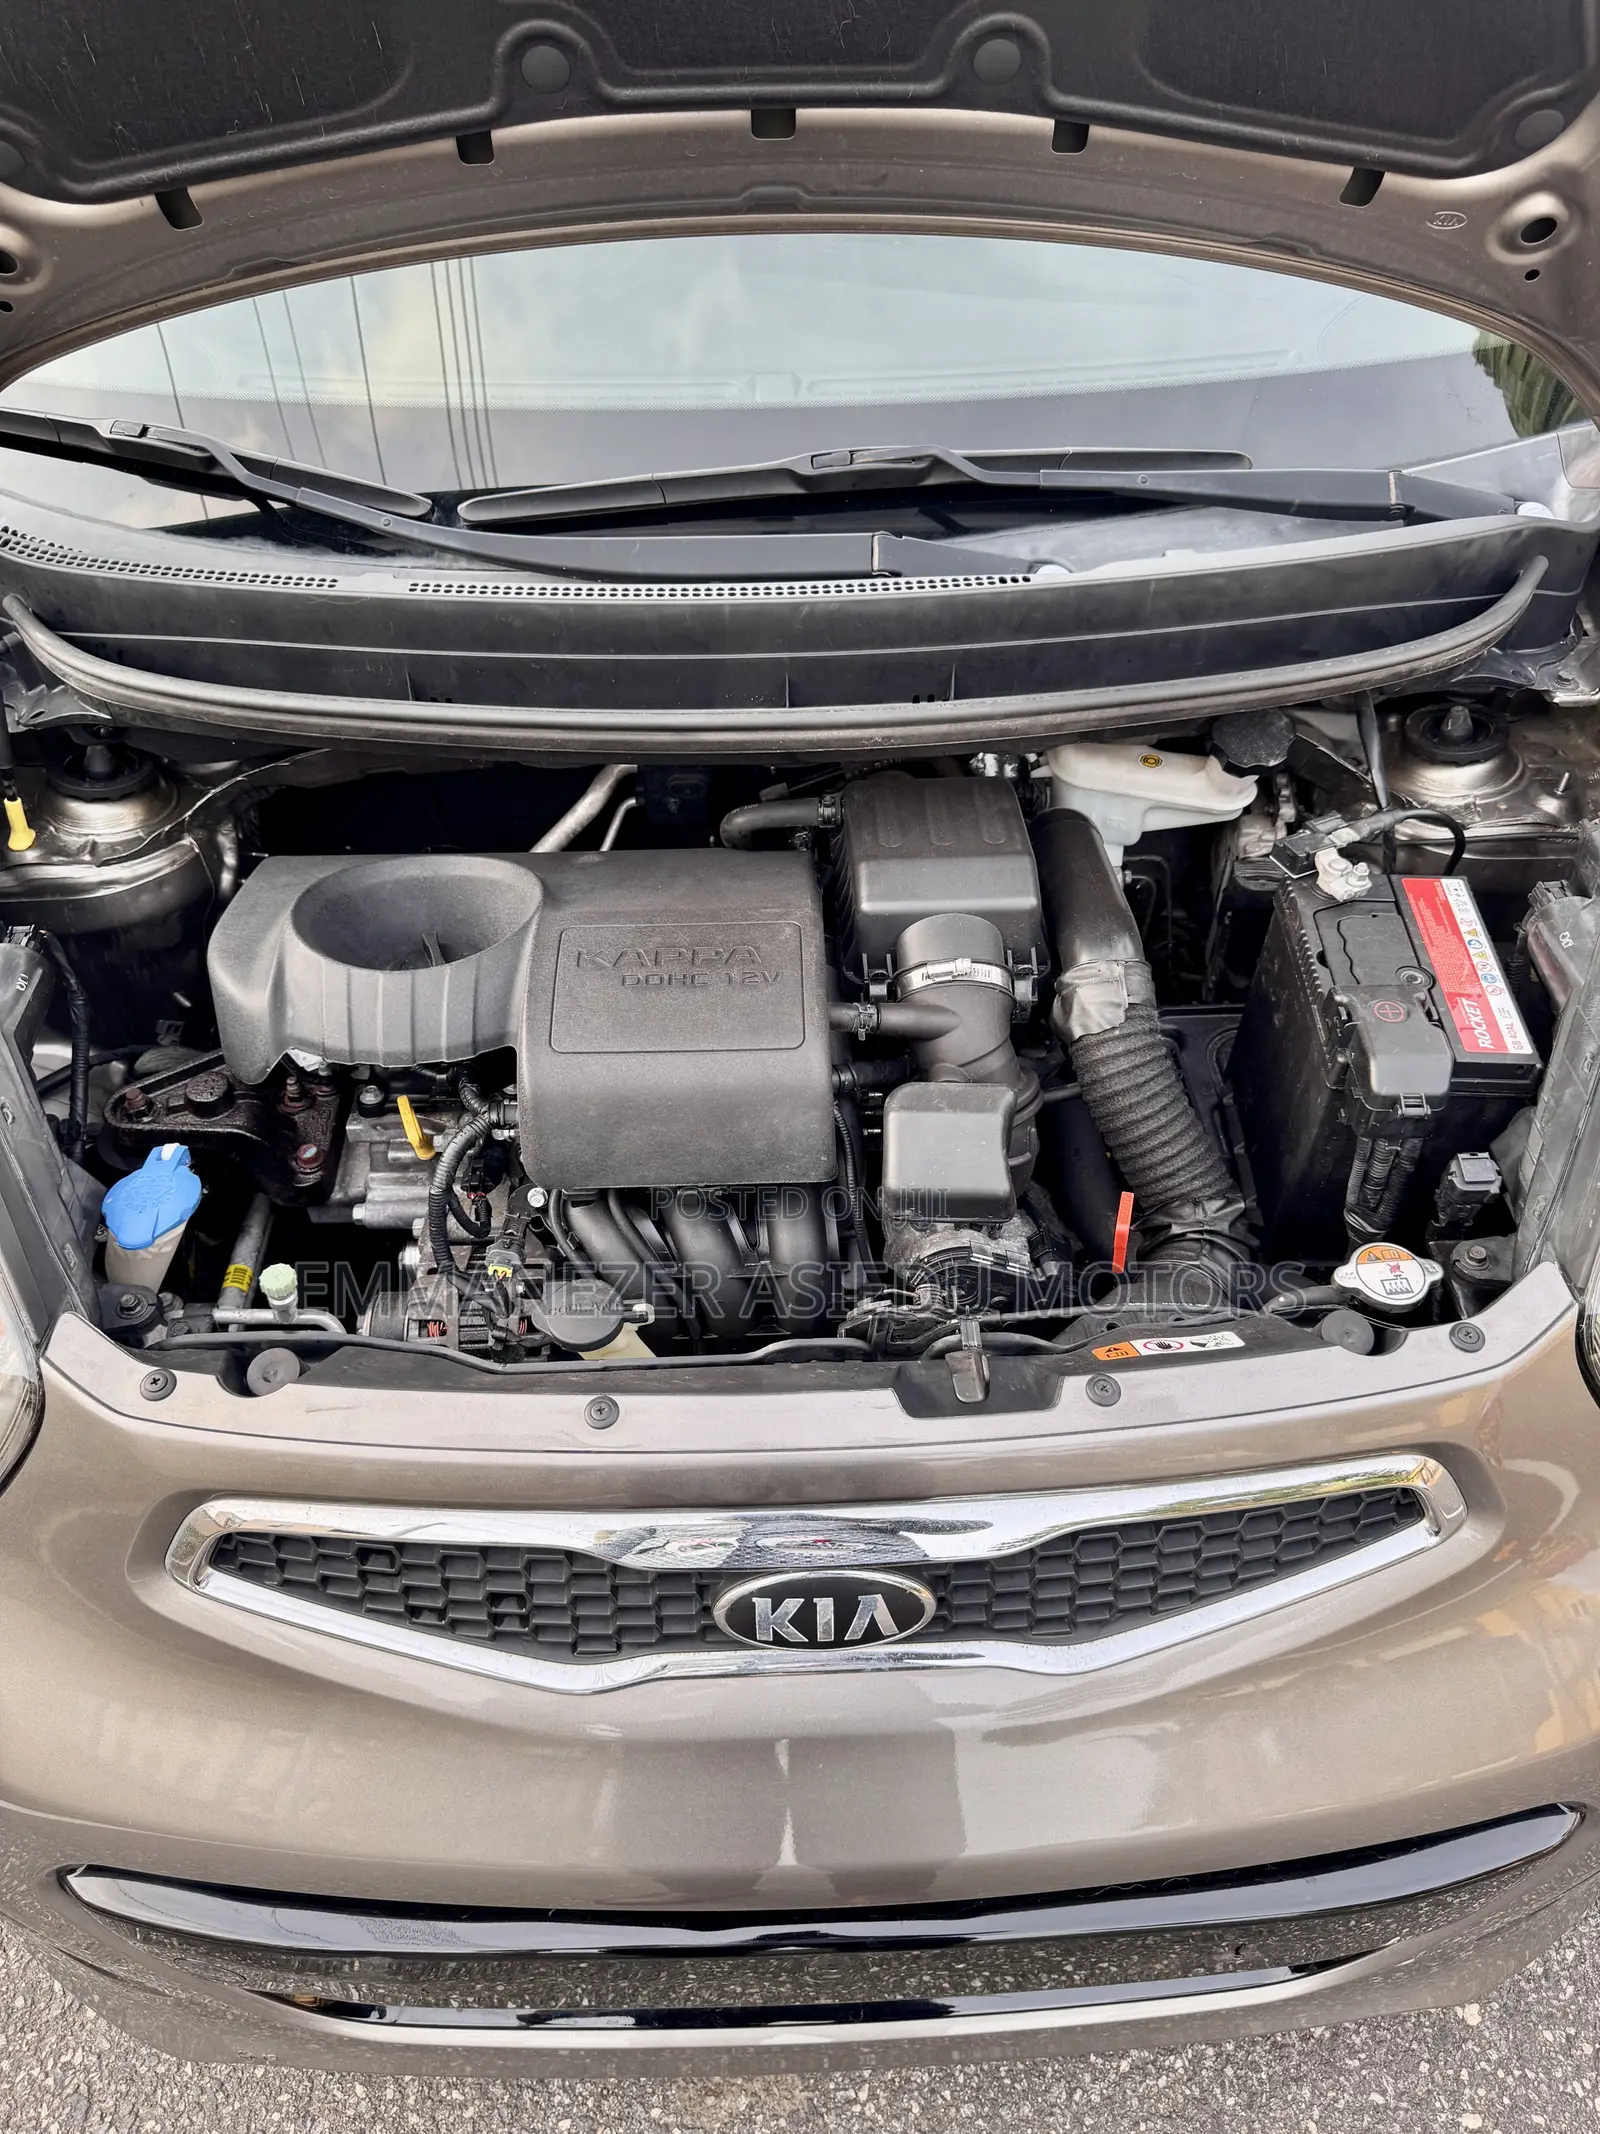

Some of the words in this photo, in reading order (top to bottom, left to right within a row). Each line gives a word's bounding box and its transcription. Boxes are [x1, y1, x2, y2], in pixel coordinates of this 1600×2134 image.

[576, 945, 763, 968] KAPPA
[621, 973, 709, 987] DOHC
[725, 970, 781, 984] 12V
[1463, 997, 1495, 1050] ROCKET
[752, 1593, 899, 1642] KIA
